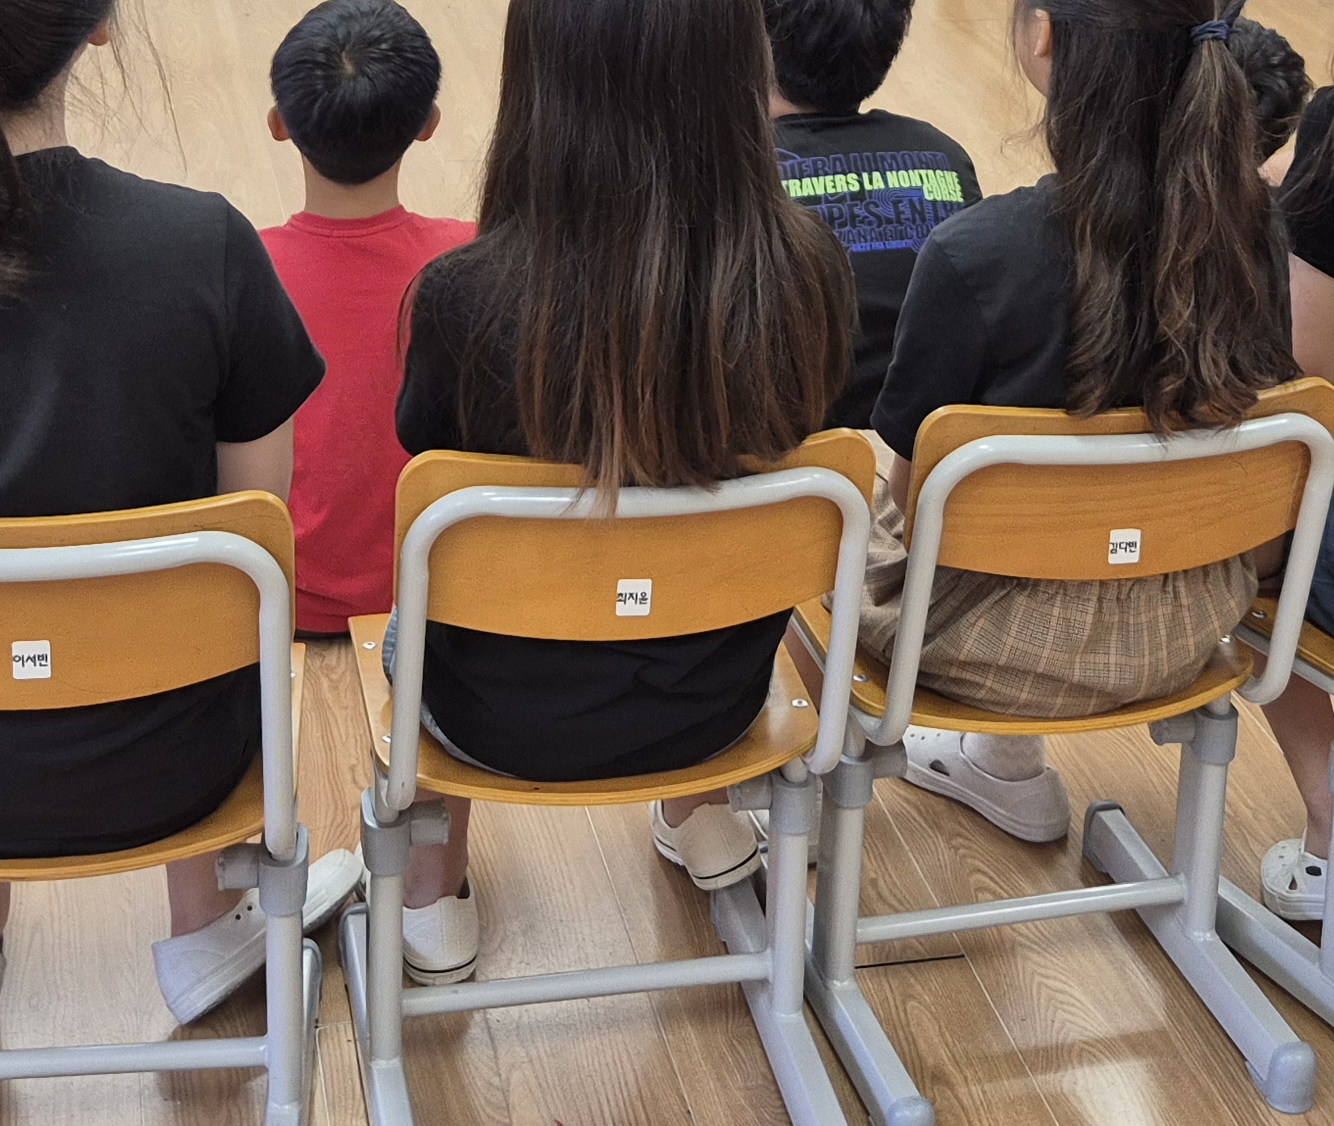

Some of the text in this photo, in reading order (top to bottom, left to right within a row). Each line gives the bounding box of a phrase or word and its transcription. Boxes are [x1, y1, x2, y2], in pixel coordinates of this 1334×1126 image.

[862, 171, 885, 191] LA
[923, 183, 964, 203] CORSE
[13, 653, 48, 668] 이서빈
